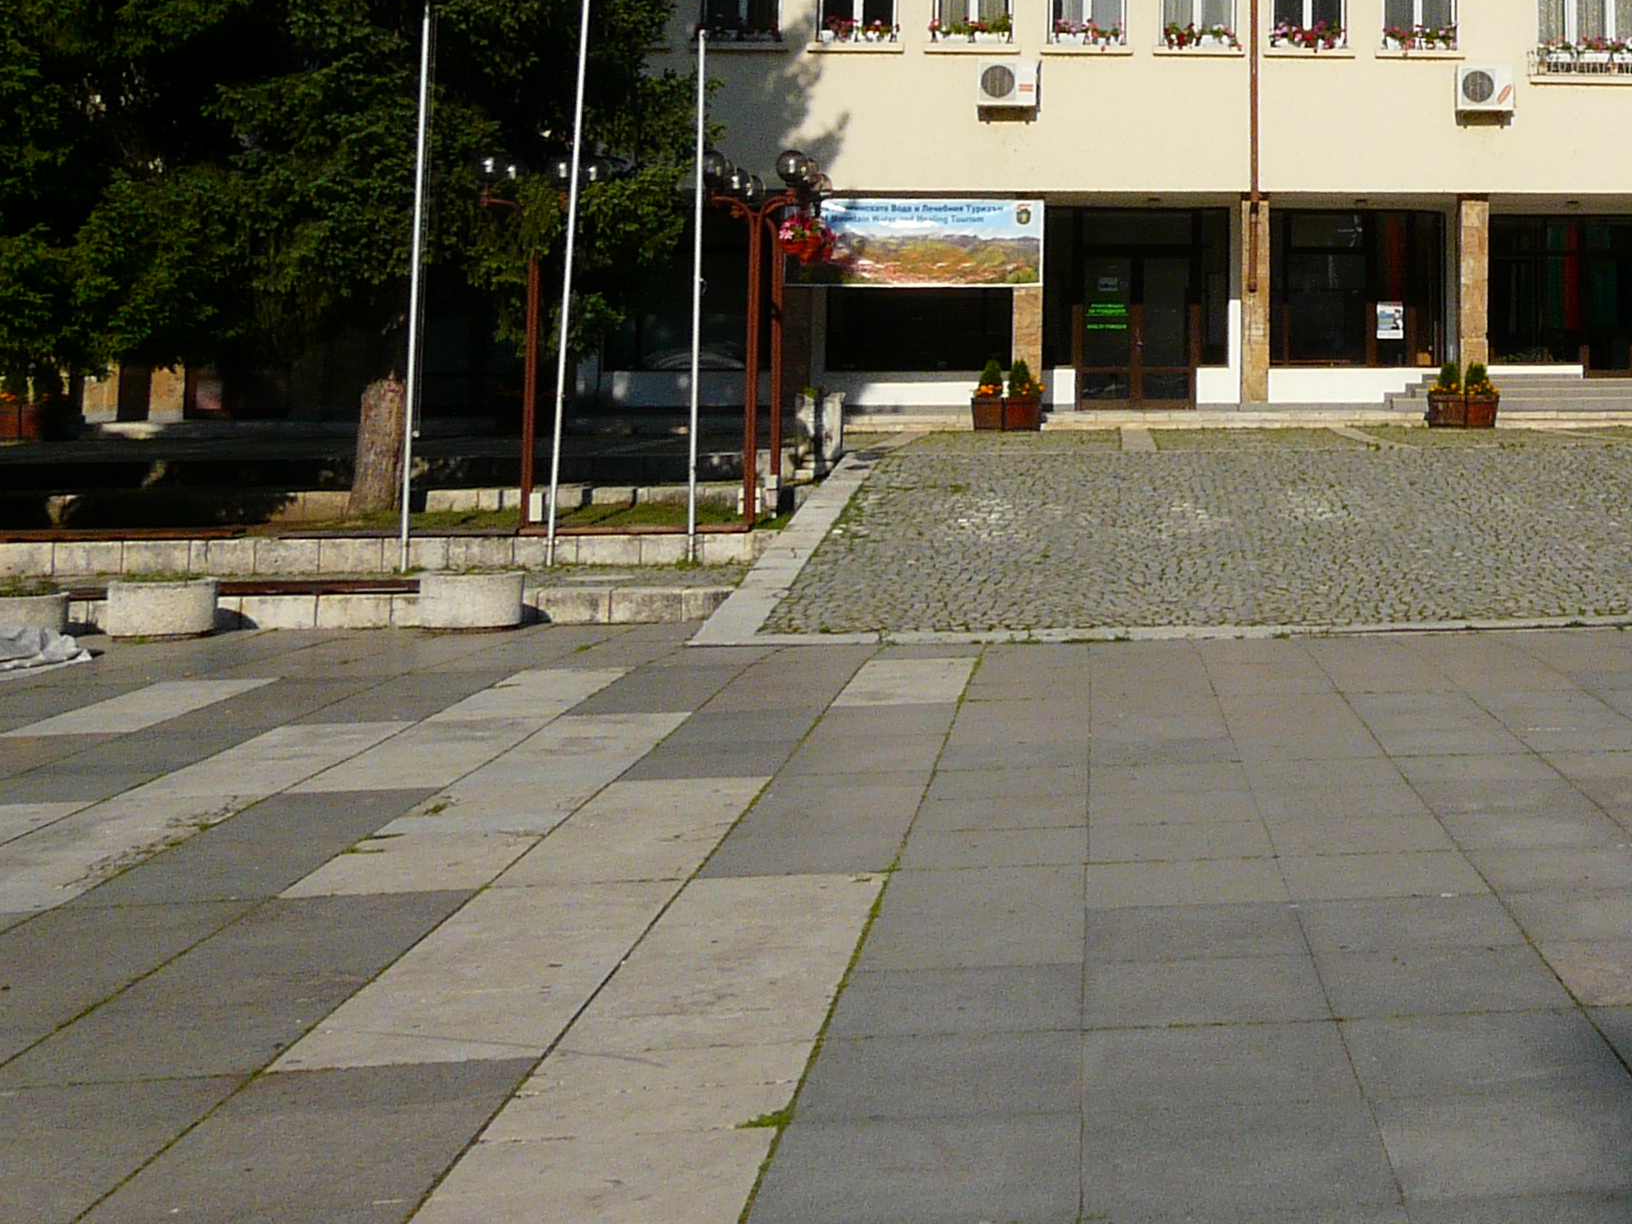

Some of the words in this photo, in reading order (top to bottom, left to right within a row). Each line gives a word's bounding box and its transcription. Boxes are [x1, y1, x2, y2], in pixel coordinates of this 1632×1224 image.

[891, 204, 912, 213] Вода
[831, 215, 870, 225] Mountain
[872, 215, 897, 223] Water
[951, 215, 984, 223] Tourism
